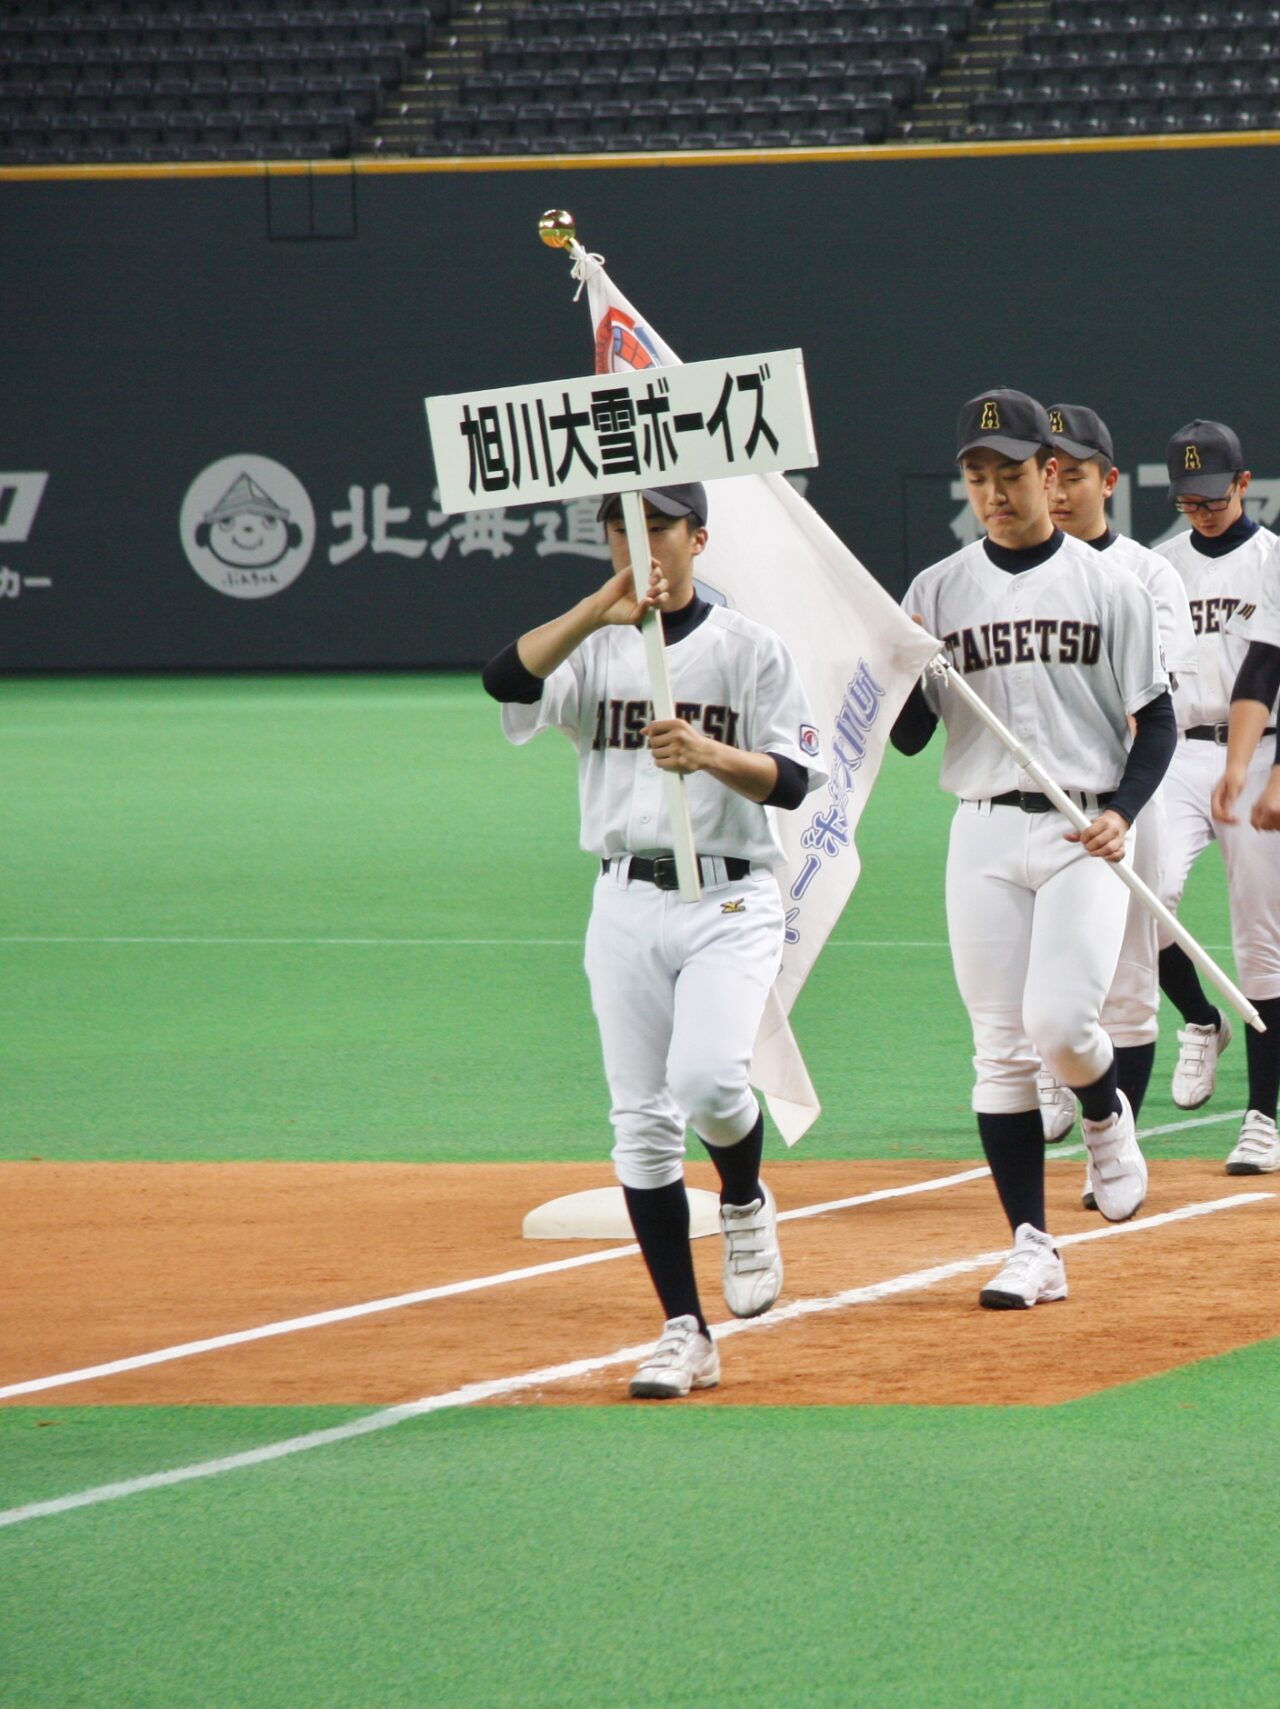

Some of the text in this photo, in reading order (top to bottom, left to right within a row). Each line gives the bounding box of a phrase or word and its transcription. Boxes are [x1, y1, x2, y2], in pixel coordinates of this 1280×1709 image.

[460, 363, 779, 495] 旭川大雪ボーイズ
[981, 402, 1000, 429] A
[1185, 445, 1201, 470] A
[943, 618, 1101, 676] TAISETSU
